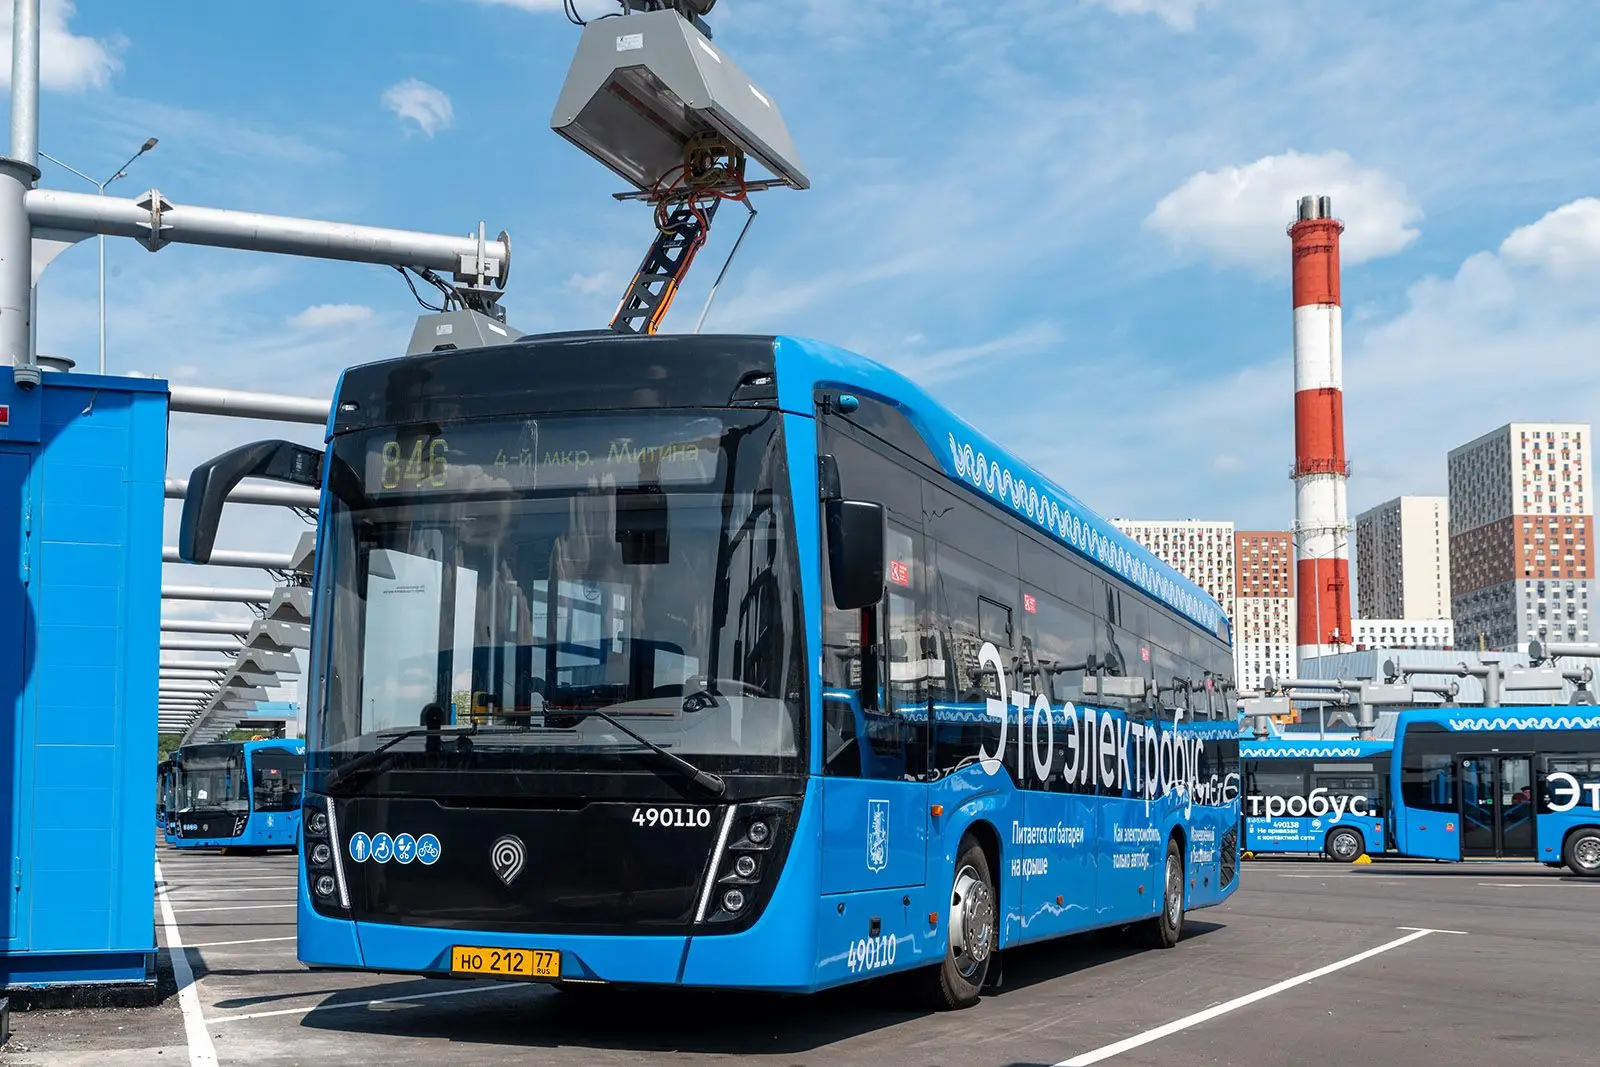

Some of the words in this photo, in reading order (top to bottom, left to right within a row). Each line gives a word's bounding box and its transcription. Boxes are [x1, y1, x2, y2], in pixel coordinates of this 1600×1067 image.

[381, 438, 449, 489] 846
[494, 448, 532, 469] 4-й
[544, 451, 594, 473] мкр.
[608, 439, 699, 467] Митина
[978, 642, 1054, 782] Это
[1240, 787, 1376, 823] тробус.
[632, 808, 711, 828] 490110
[1273, 821, 1299, 829] 490138
[1012, 820, 1047, 844] Питается
[1048, 828, 1056, 844] от
[1057, 821, 1084, 848] батареи
[1113, 822, 1123, 842] Как
[1011, 860, 1021, 876] на
[1022, 857, 1048, 880] крыше
[490, 951, 524, 972] 212
[535, 952, 553, 968] 77
[848, 933, 896, 973] 490110
